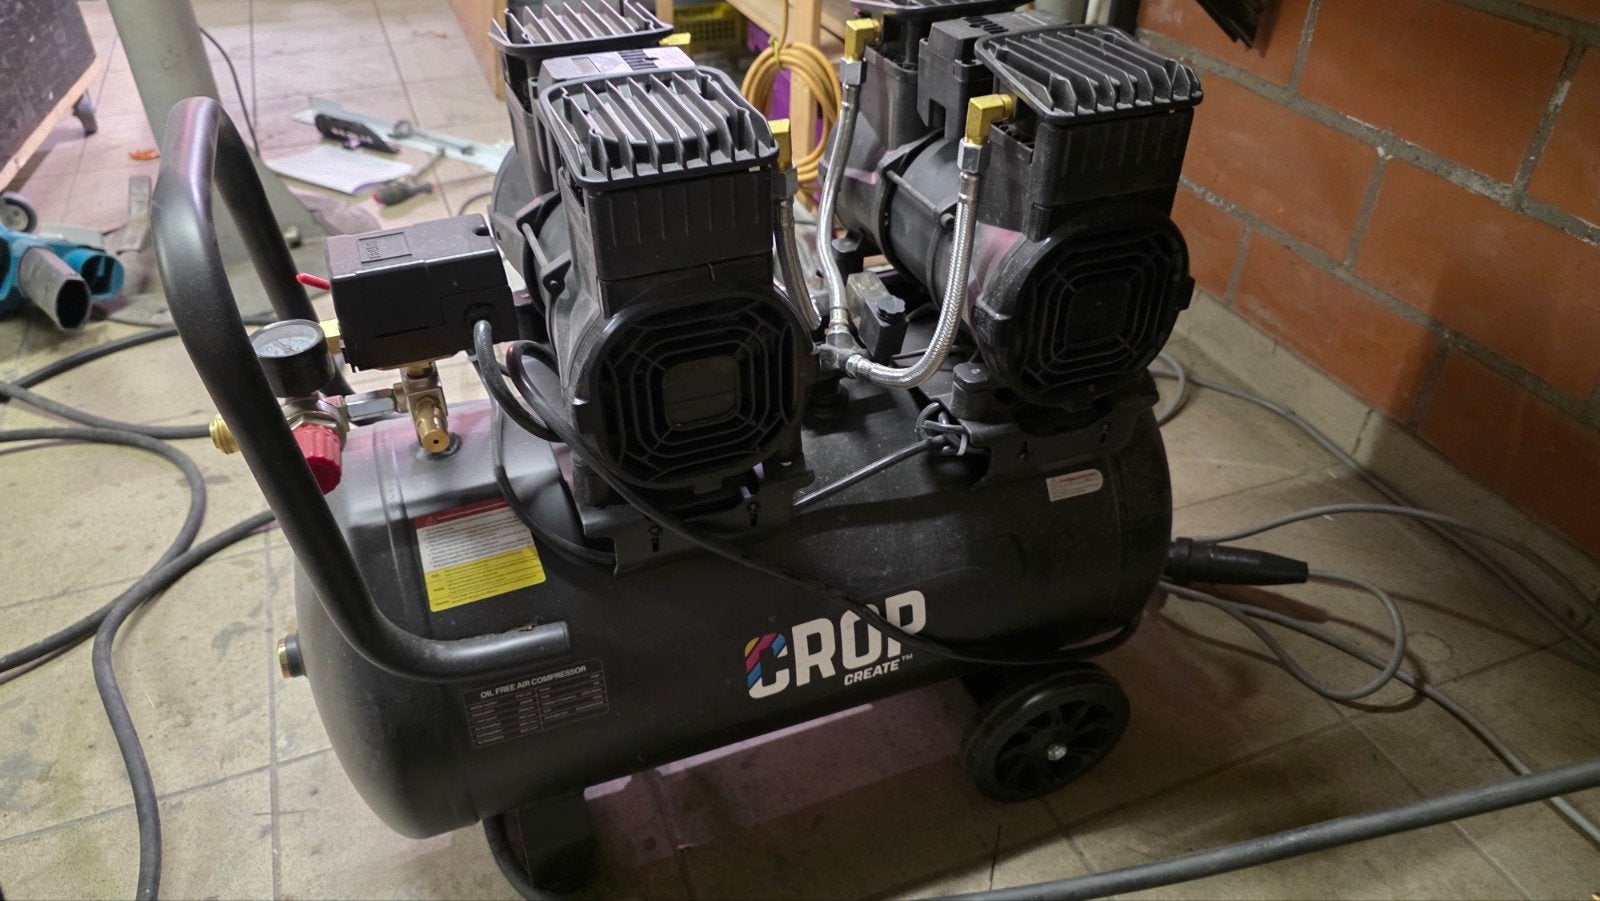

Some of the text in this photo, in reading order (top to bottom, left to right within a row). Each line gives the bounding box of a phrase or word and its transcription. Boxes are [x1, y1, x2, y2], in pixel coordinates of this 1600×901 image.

[744, 590, 927, 699] CROP
[480, 690, 495, 699] OIL
[495, 683, 517, 695] FREE
[516, 680, 531, 690] AIR
[531, 665, 587, 686] COMPRESSOR
[843, 658, 901, 686] CREATE
